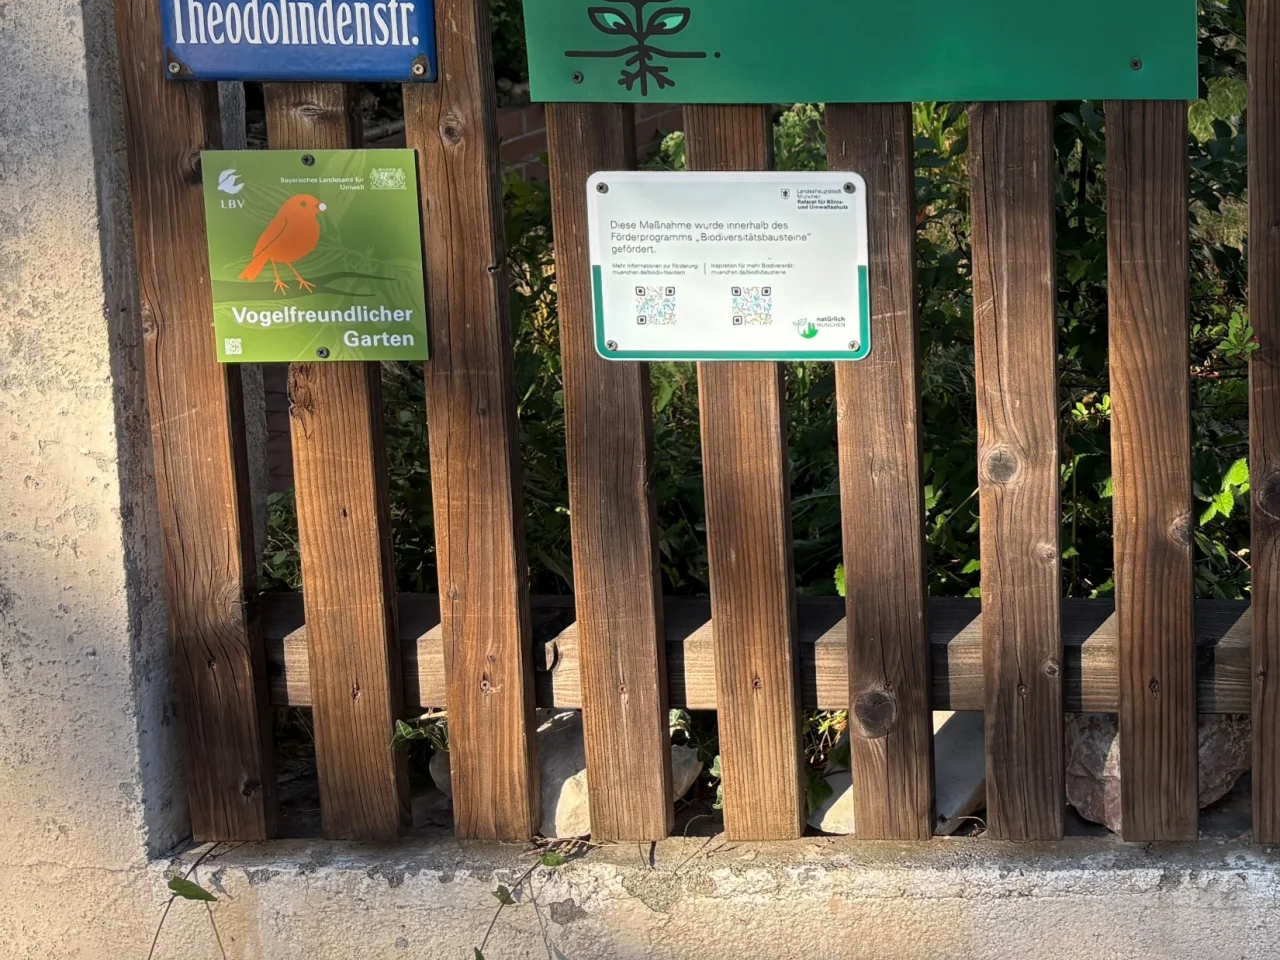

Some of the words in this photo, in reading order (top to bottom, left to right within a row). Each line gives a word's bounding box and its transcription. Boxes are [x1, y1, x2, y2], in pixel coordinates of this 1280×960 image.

[220, 199, 245, 209] LBV
[610, 220, 636, 230] Diese
[639, 220, 692, 230] Maßnahme
[694, 220, 724, 230] wurde
[726, 220, 769, 230] innerhalb
[771, 220, 788, 230] des
[610, 232, 693, 243] Förderprogramms
[611, 244, 657, 255] gefördert.
[231, 305, 414, 327] Vogelfreundlicher
[343, 329, 415, 348] Garten
